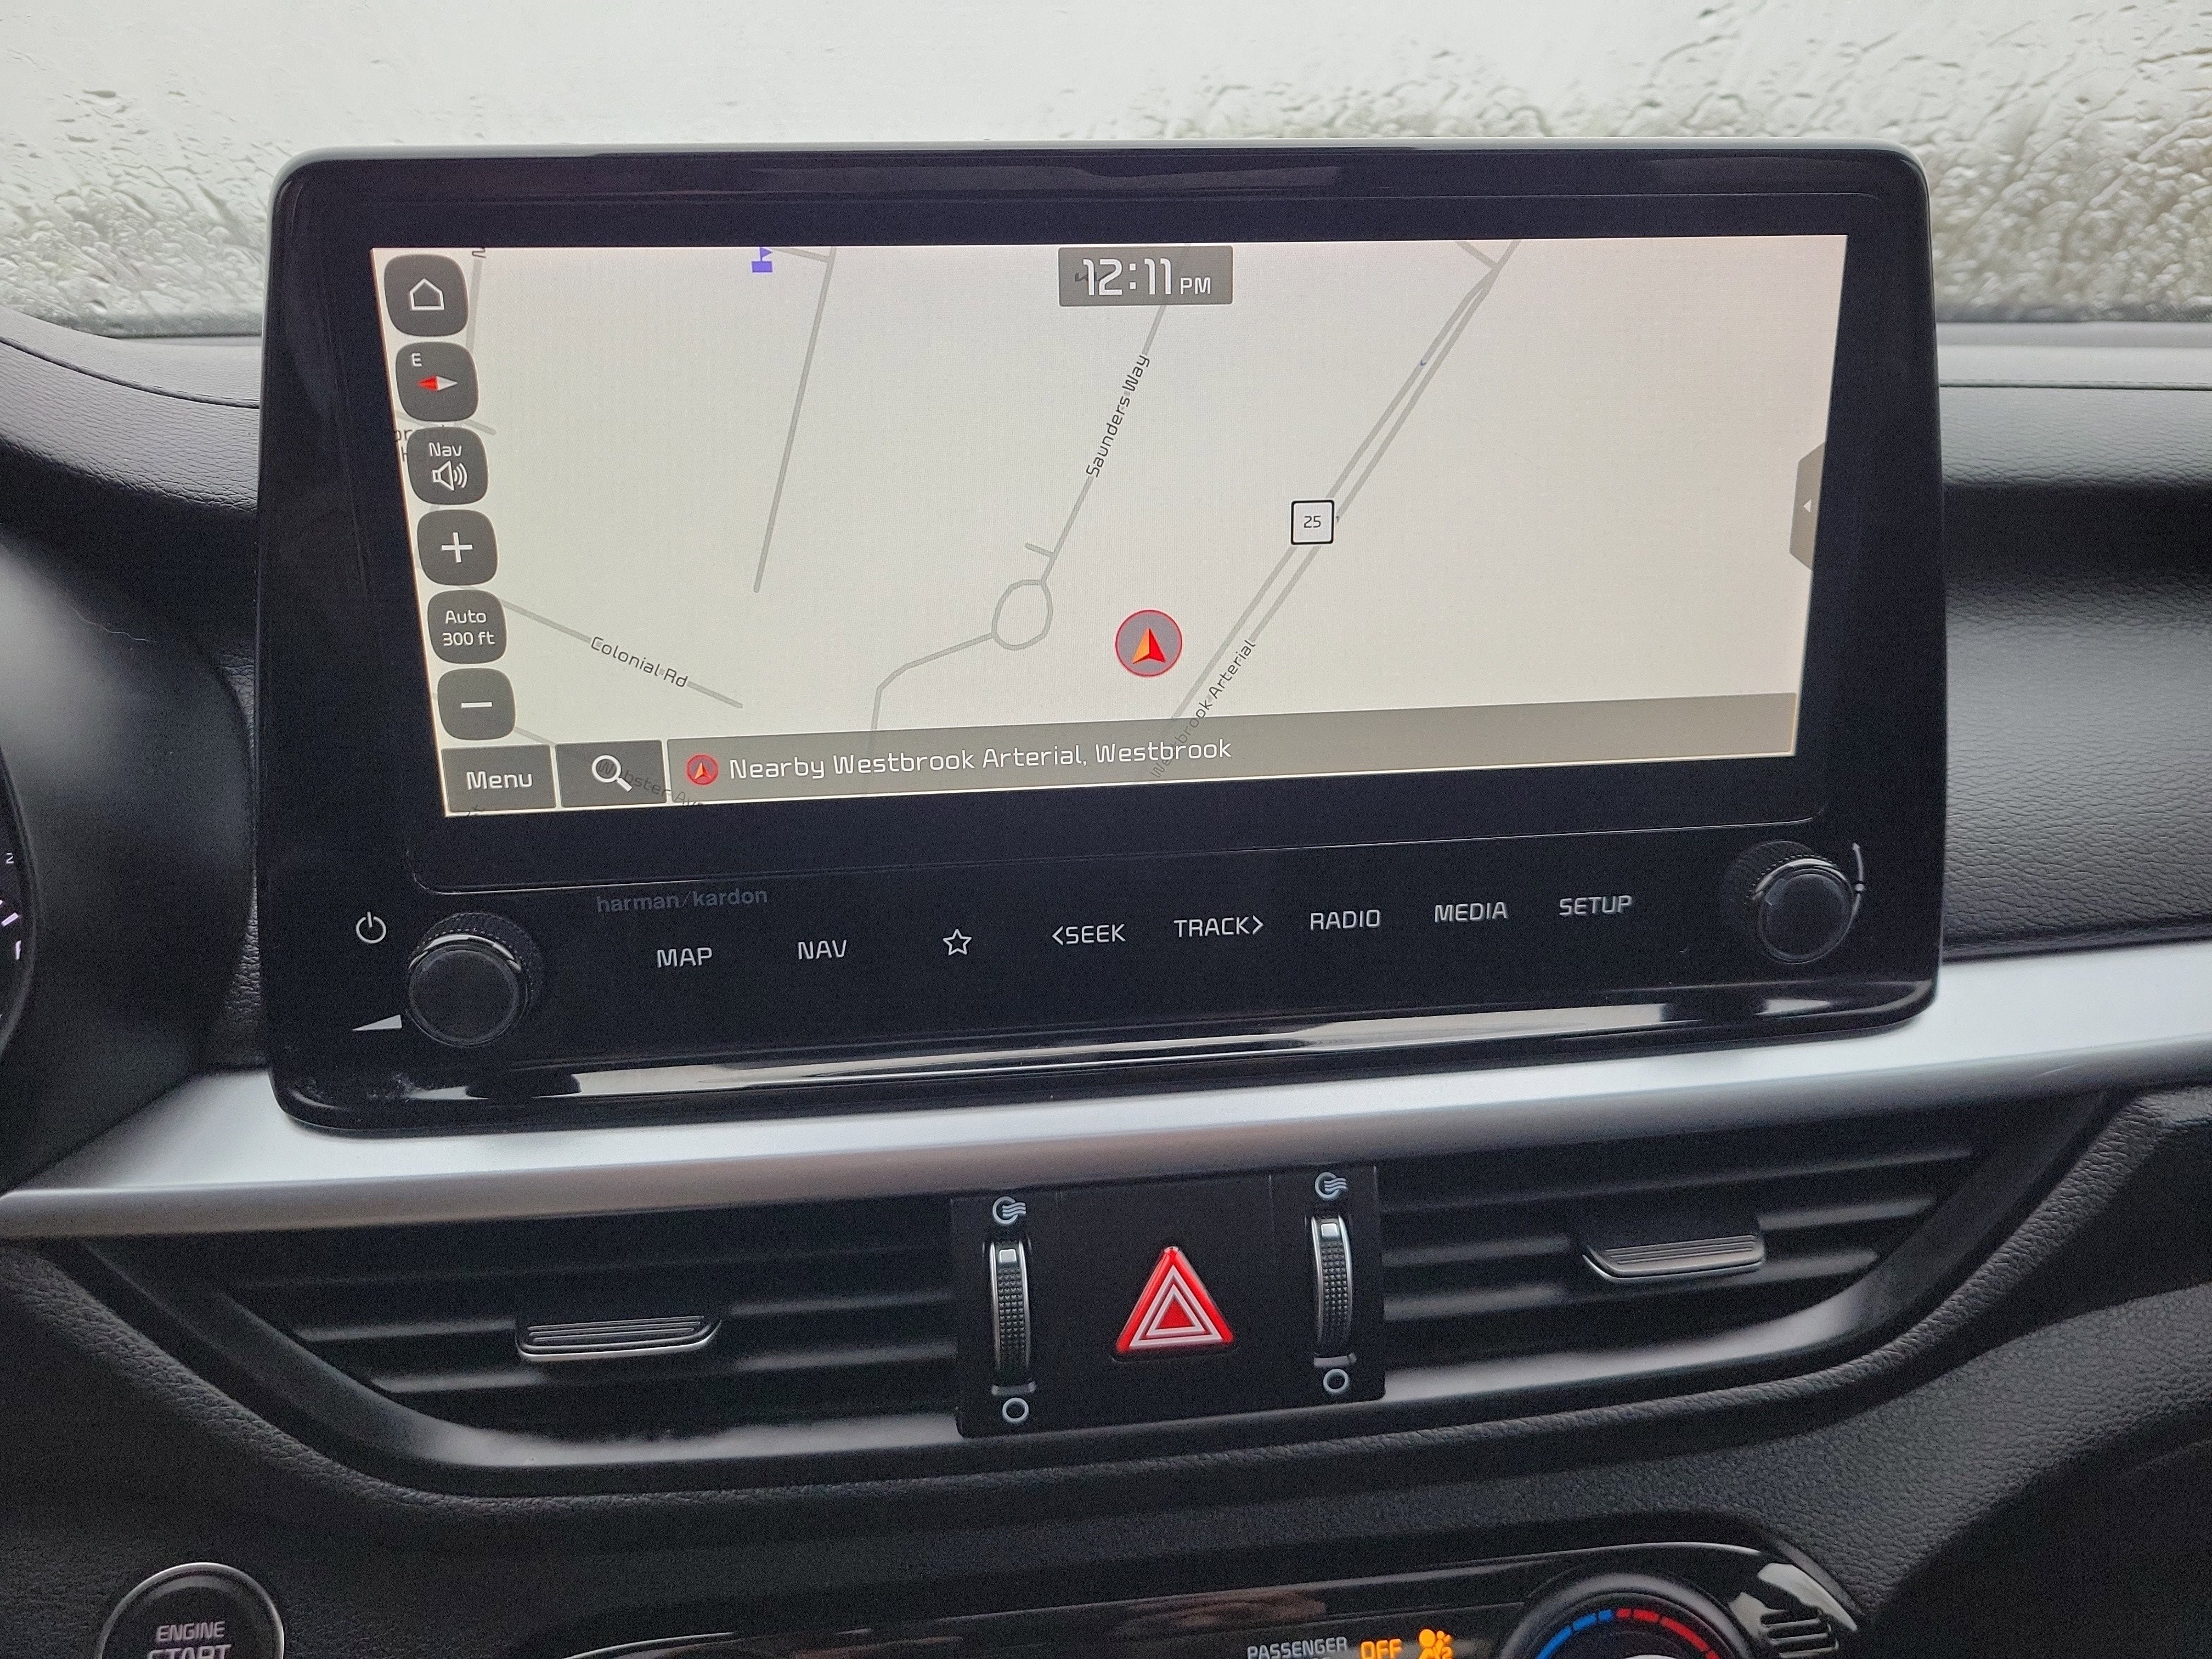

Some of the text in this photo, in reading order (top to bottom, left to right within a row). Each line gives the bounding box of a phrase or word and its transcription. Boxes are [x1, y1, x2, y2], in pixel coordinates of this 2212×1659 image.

[1082, 257, 1211, 296] 12:11 PM
[411, 353, 422, 367] E
[1086, 354, 1150, 478] Saunders Way
[429, 442, 462, 457] Nav
[1304, 515, 1322, 528] 25
[445, 610, 487, 624] Auto
[442, 630, 495, 646] 300 ft
[591, 636, 689, 688] Colonial Rd
[1150, 639, 1256, 778] Wetbrook Arterial
[730, 738, 1232, 779] Nearby Westbrook Arterial, Westbrook
[467, 771, 533, 791] Menu
[597, 761, 672, 797] Wbster
[596, 888, 768, 913] harman/kardon
[1559, 895, 1633, 917] SETUP
[1310, 909, 1380, 930] RADIO
[1434, 901, 1508, 923] MEDIA
[657, 947, 713, 968] MAP
[798, 939, 847, 960] NAV
[156, 1621, 226, 1642] ENGINE
[1247, 1636, 1402, 1659] PASSENGER OFF
